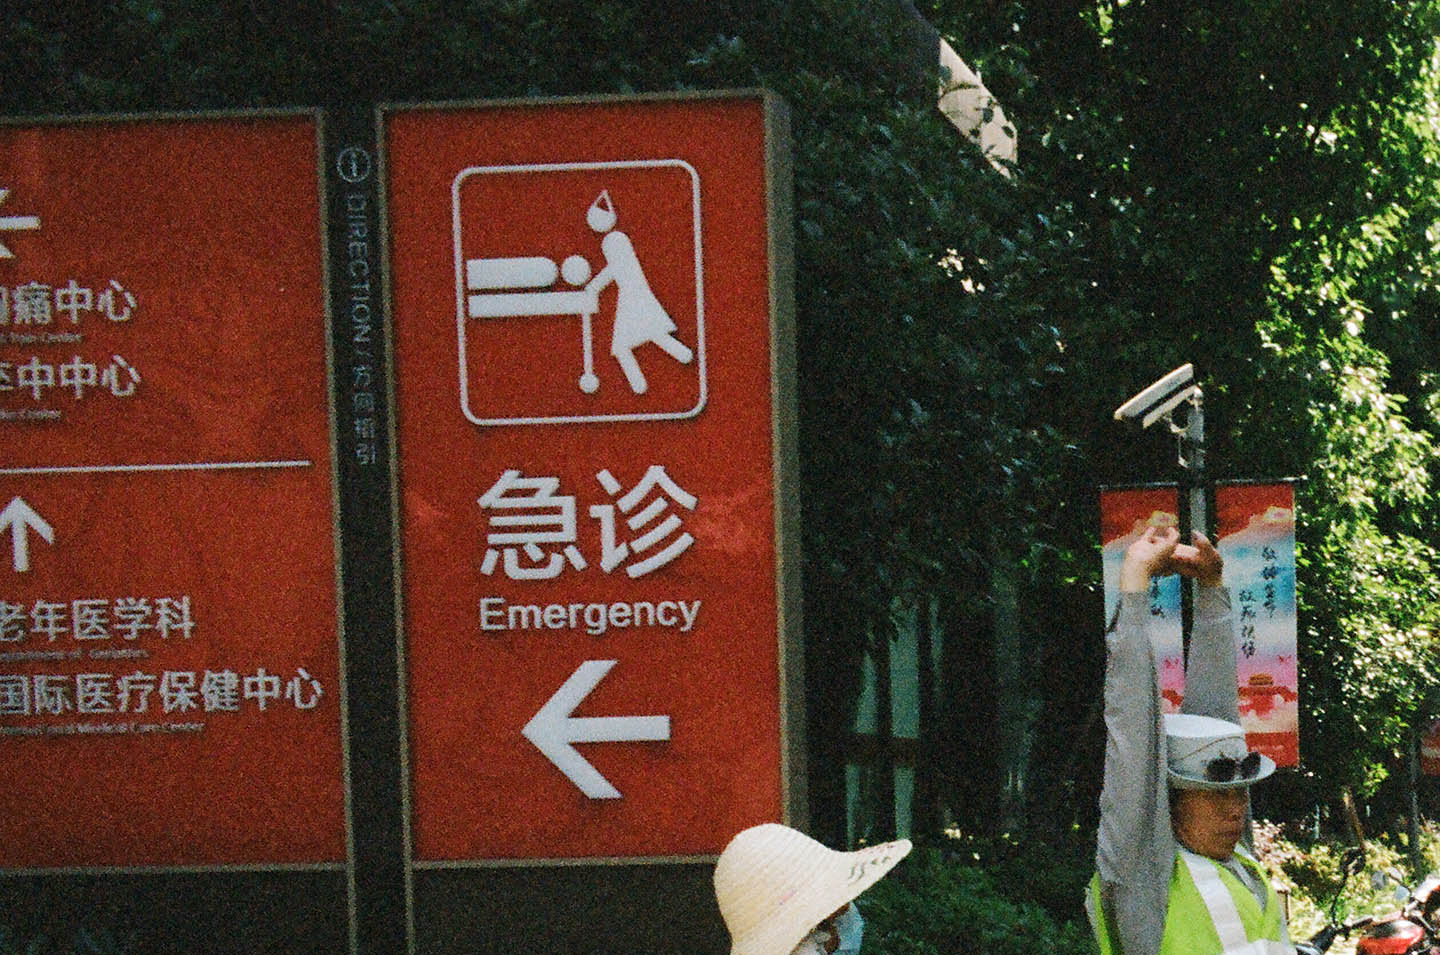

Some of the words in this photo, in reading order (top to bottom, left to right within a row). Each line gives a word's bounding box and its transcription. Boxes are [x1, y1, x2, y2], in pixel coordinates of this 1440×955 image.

[348, 193, 372, 343] DIRECTION
[0, 279, 137, 325] 痛中心
[477, 465, 699, 580] 急诊
[0, 596, 196, 642] 老年医学科
[479, 597, 702, 636] Emergency
[0, 667, 324, 716] 国际医疗保健中心
